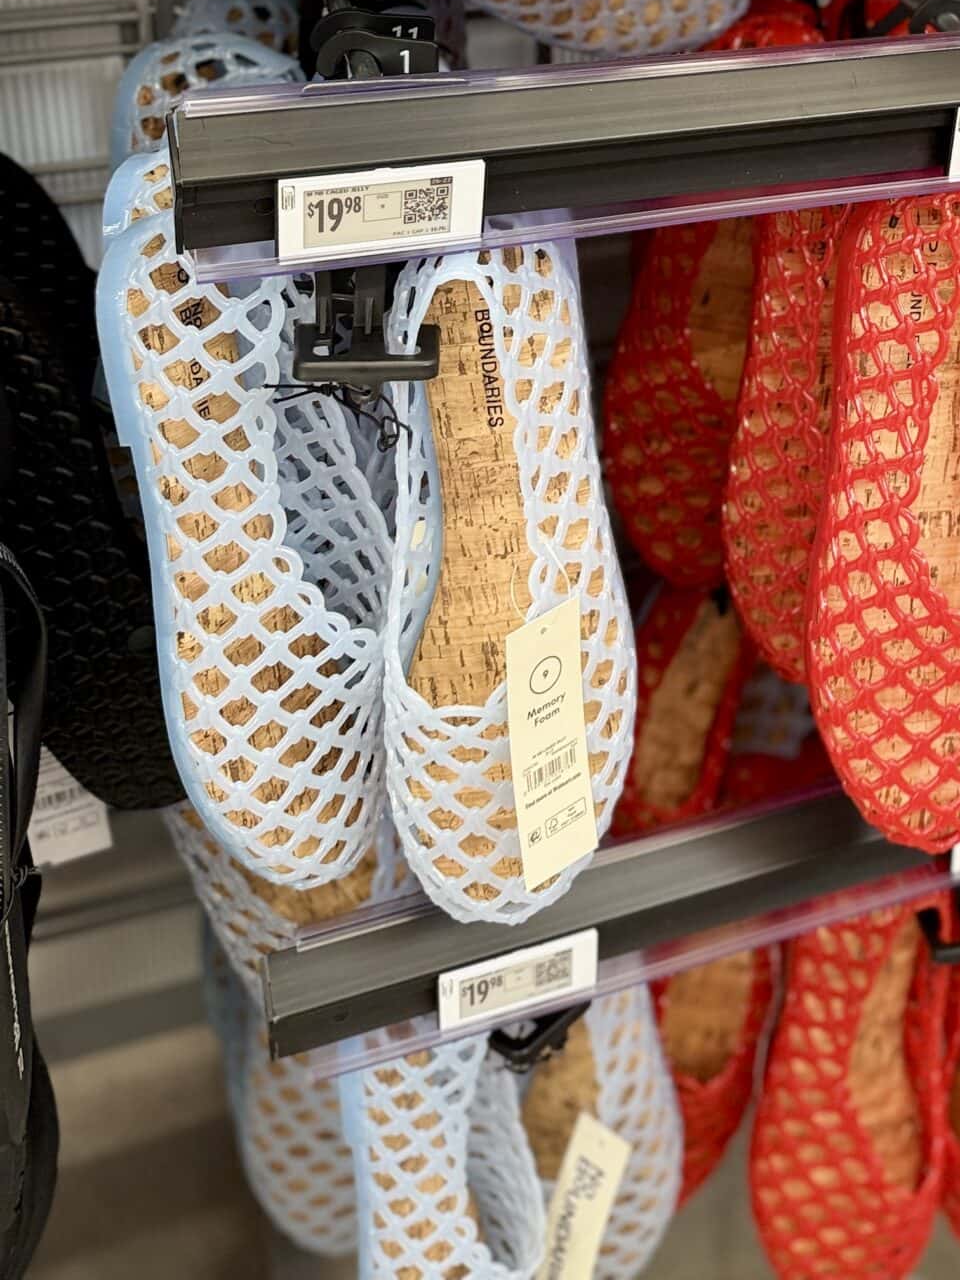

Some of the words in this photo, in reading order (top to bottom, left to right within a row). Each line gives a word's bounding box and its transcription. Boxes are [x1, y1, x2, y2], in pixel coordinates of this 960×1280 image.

[474, 308, 505, 428] BOUNDARIES
[527, 691, 566, 720] Memory
[534, 706, 561, 727] Foam
